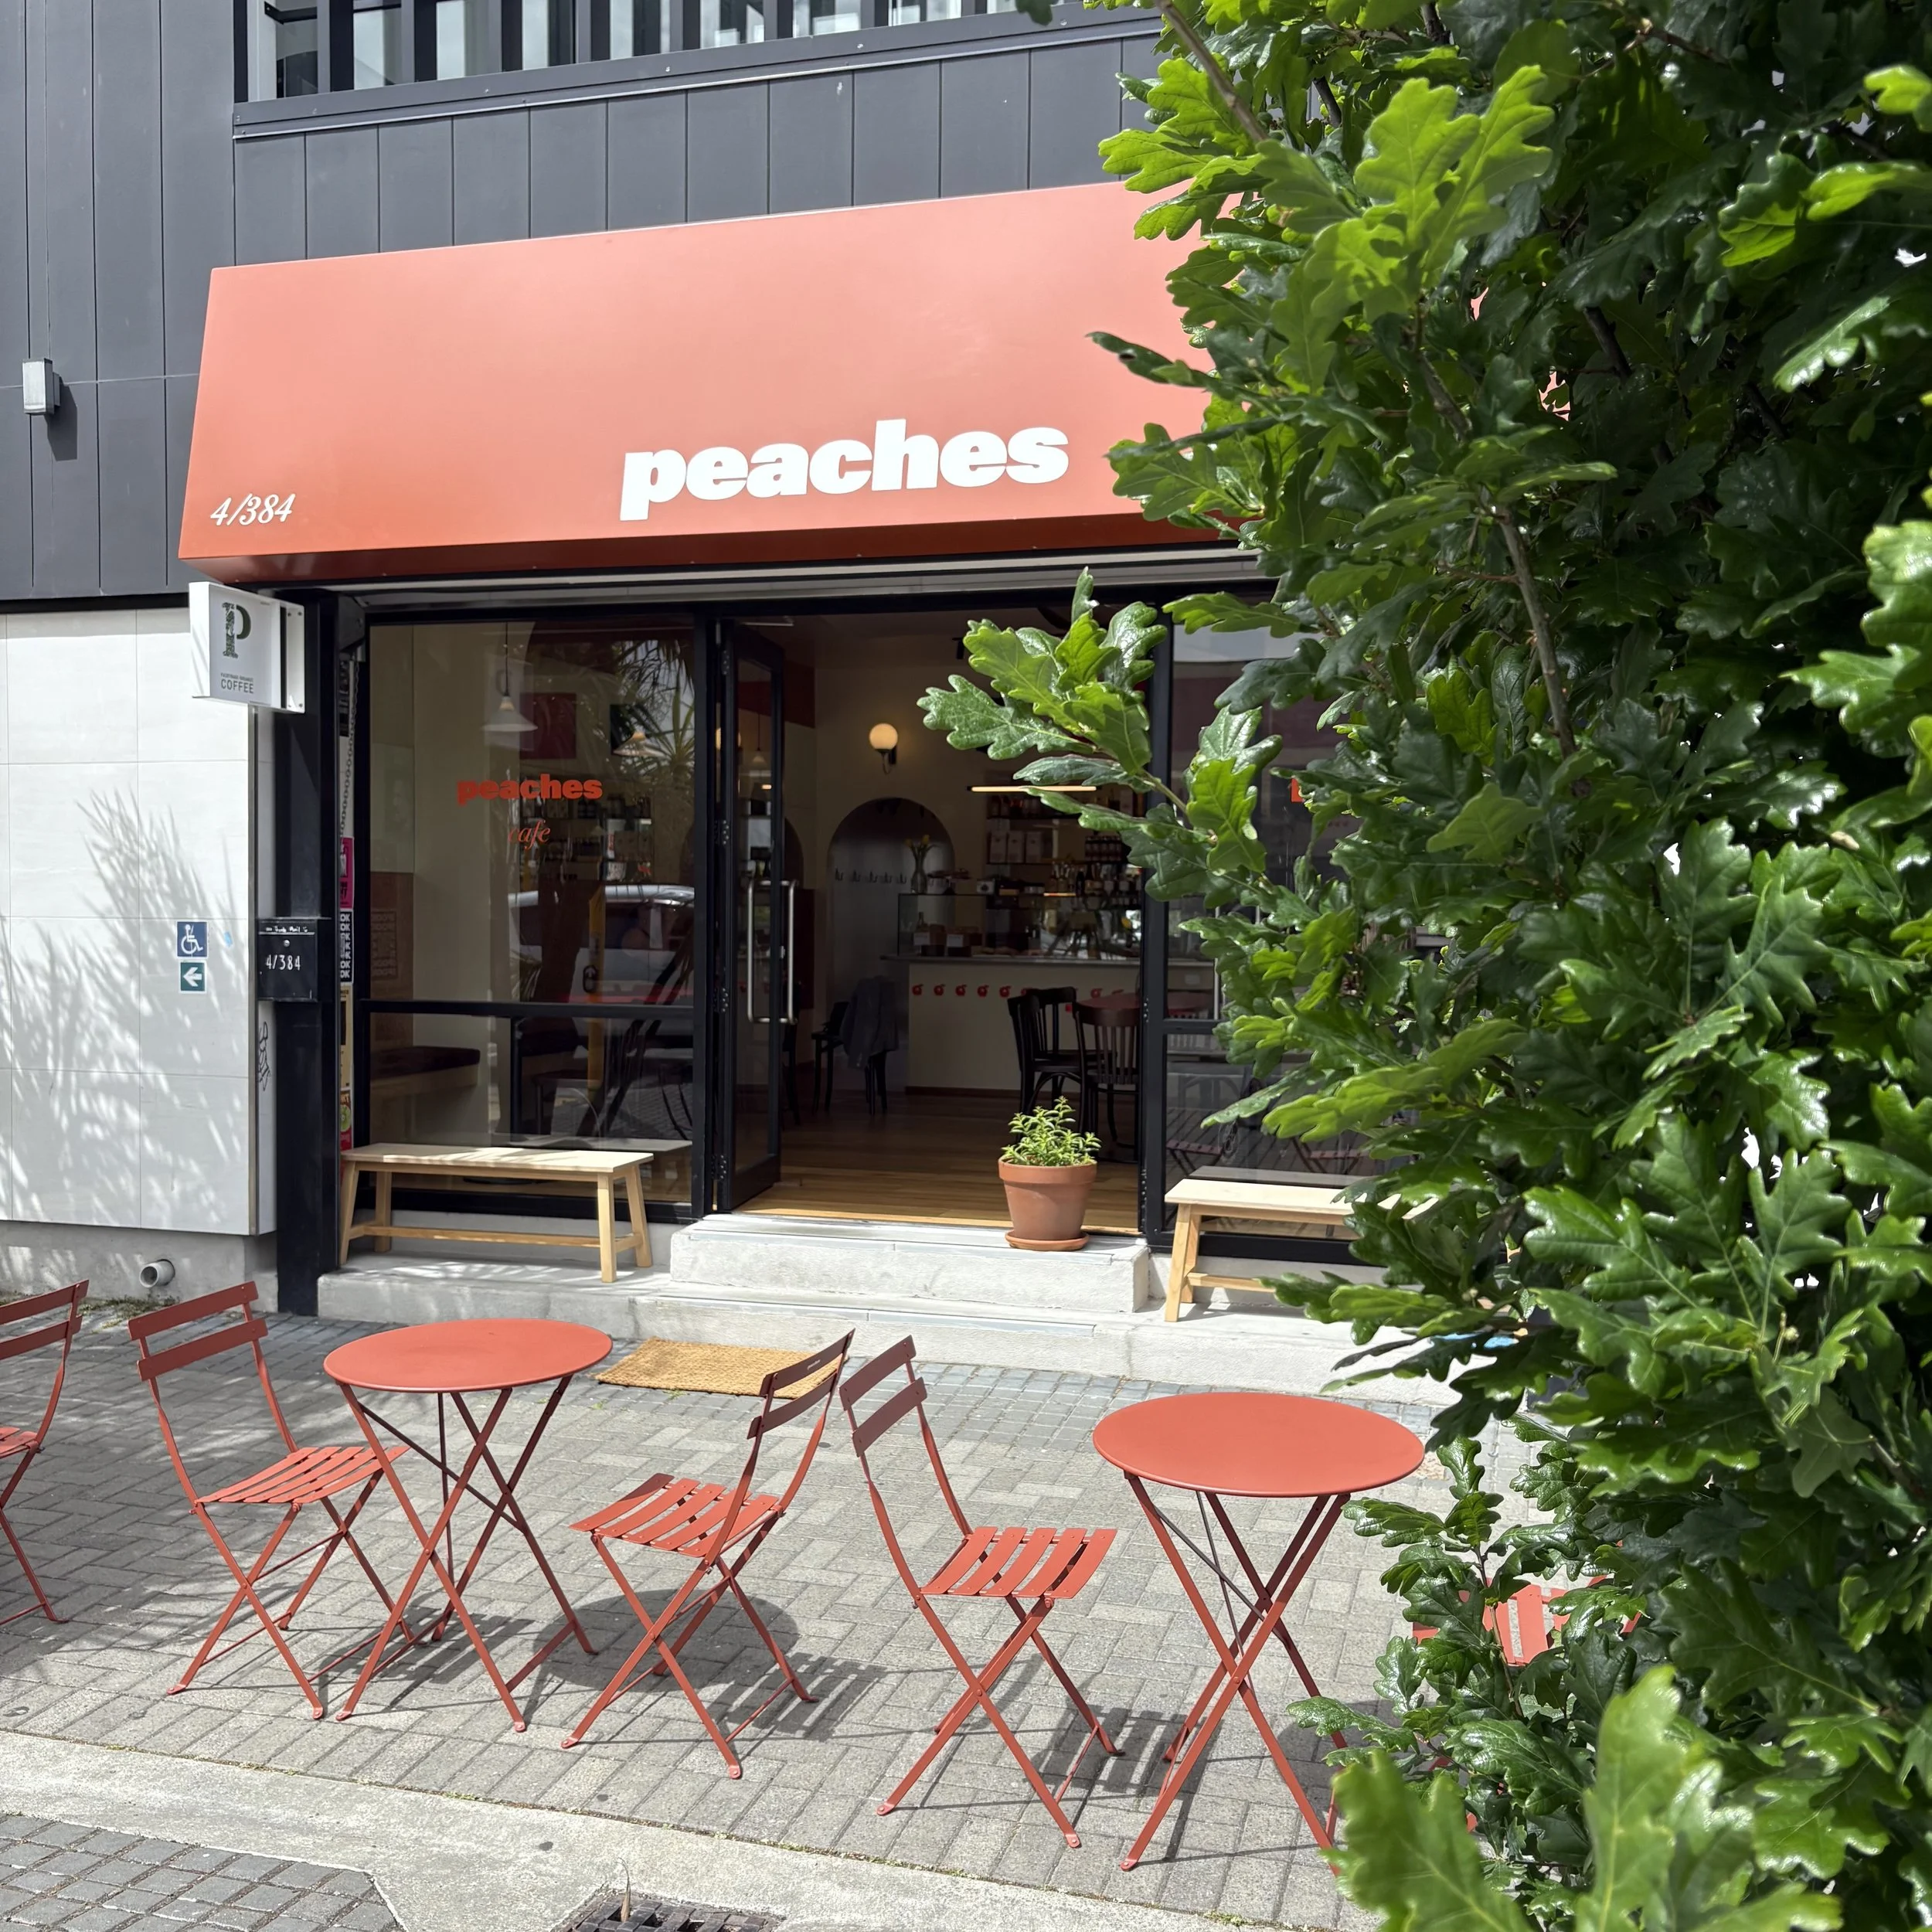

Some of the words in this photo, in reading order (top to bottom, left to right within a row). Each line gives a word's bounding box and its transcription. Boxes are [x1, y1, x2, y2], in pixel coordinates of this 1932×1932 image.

[620, 418, 1069, 521] peaches
[210, 493, 296, 526] 4/384
[221, 679, 254, 694] COFFEE
[457, 774, 603, 806] peaches
[266, 954, 301, 971] 4/384
